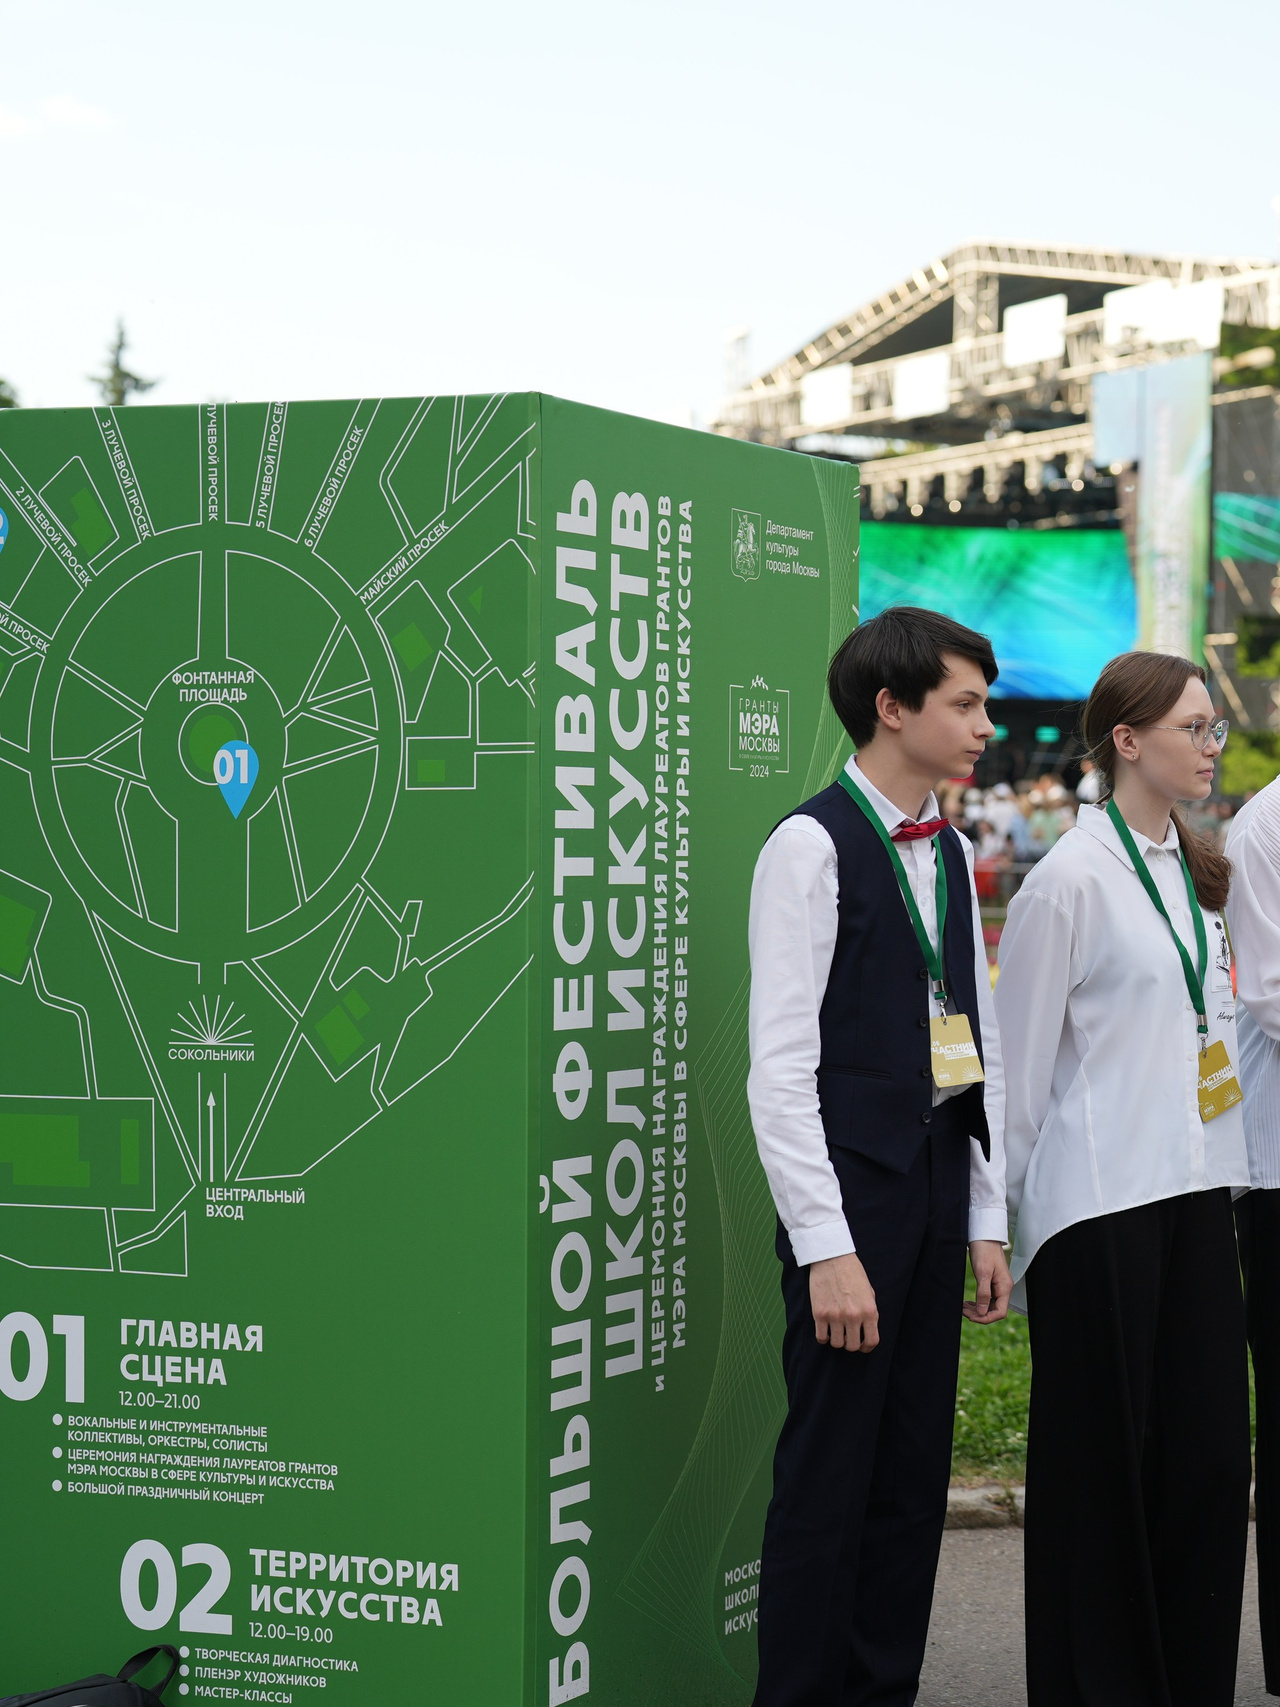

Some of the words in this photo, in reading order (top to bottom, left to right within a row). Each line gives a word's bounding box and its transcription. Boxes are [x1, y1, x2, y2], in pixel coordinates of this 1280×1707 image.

[101, 419, 112, 429] 3
[105, 430, 134, 488] ЛУЧЕВОЙ
[258, 455, 275, 518] ЛУЧЕВОЙ
[267, 401, 285, 452] ПРОСЕК
[208, 467, 218, 521] ПРОСЕК
[305, 539, 313, 547] 6
[309, 478, 340, 538] ЛУЧЕВОЙ
[335, 426, 363, 477] ПРОСЕК
[127, 489, 151, 540] ПРОСЕК
[16, 486, 24, 496] 2
[22, 495, 61, 545] ЛУЧЕВОЙ
[58, 543, 92, 587] ПРОСЕК
[766, 520, 814, 540] Департамент
[360, 556, 410, 604] МАЙСКИЙ
[407, 520, 449, 561] ПРОСЕК
[766, 542, 798, 558] культуры
[656, 496, 671, 650] ГРАНТОВ
[766, 560, 790, 574] города
[793, 561, 819, 577] Москвы
[677, 501, 692, 703] ИСКУССТВА
[9, 620, 50, 653] ПРОСЕК
[172, 671, 255, 687] ФОНТАННАЯ
[179, 688, 248, 704] ПЛОЩАДЬ
[739, 698, 779, 713] ГРАНТЫ
[677, 715, 689, 736] И
[740, 712, 779, 735] МЭРА
[739, 736, 780, 752] МОСКВЫ
[213, 749, 250, 784] 01
[607, 491, 650, 1032] ИСКУССТВ
[655, 662, 669, 863] ЛАУРЕАТОВ
[750, 764, 769, 777] 2024
[552, 479, 598, 1120] ФЕСТИВАЛЬ
[675, 748, 689, 924] КУЛЬТУРЫ
[652, 872, 668, 1135] НАГРАЖДЕНИЯ
[674, 937, 688, 1054] СФЕРЕ
[169, 1049, 254, 1061] СОКОЛЬНИКИ
[931, 1042, 976, 1055] ЧАСТНИК
[674, 1061, 686, 1080] В
[1198, 1063, 1233, 1089] ЧАСТНИК
[674, 1101, 686, 1246] МОСКВЫ
[206, 1188, 304, 1203] ЦЕНТРАЛЬНЫЙ
[207, 1205, 243, 1220] ВХОД
[606, 1069, 646, 1378] ШКОЛ
[652, 1147, 666, 1365] ЦЕРЕМОНИЯ
[673, 1258, 686, 1349] МЭРА
[121, 1319, 262, 1352] ГЛАВНАЯ
[0, 1311, 85, 1403] 01
[120, 1354, 227, 1387] СЦЕНА
[656, 1376, 664, 1391] и
[69, 1416, 136, 1429] ВОКАЛЬНЫЕ
[140, 1420, 146, 1430] И
[150, 1420, 267, 1437] ИНСТРУМЕНТАЛЬНЫЕ
[540, 1156, 592, 1707] БОЛЬШОЙ
[68, 1431, 145, 1446] КОЛЛЕКТИВЫ,
[148, 1435, 209, 1450] ОРКЕСТРЫ,
[213, 1439, 267, 1452] СОЛИСТЫ
[69, 1449, 136, 1462] ЦЕРЕМОНИЯ
[140, 1453, 220, 1467] НАГРАЖДЕНИЯ
[223, 1458, 285, 1472] ЛАУРЕАТОВ
[289, 1462, 338, 1475] ГРАНТОВ
[68, 1464, 96, 1475] МЭРА
[100, 1466, 148, 1478] МОСКВЫ
[152, 1469, 158, 1478] В
[161, 1469, 196, 1481] СФЕРЕ
[200, 1472, 255, 1485] КУЛЬТУРЫ
[259, 1475, 266, 1485] И
[270, 1476, 334, 1490] ИСКУССТВА
[68, 1482, 124, 1495] БОЛЬШОЙ
[128, 1486, 210, 1500] ПРАЗДНИЧНЫЙ
[213, 1491, 264, 1504] КОНЦЕРТ
[250, 1549, 458, 1591] ТЕРРИТОРИЯ
[725, 1559, 762, 1587] моско
[120, 1540, 232, 1635] 02
[725, 1584, 760, 1611] школ
[252, 1584, 442, 1626] ИСКУССТВА
[725, 1608, 759, 1635] искус
[195, 1648, 269, 1664] ТВОРЧЕСКАЯ
[273, 1655, 358, 1671] ДИАГНОСТИКА
[196, 1667, 241, 1680] ПЛЕНЭР
[245, 1671, 326, 1687] ХУДОЖНИКОВ
[195, 1686, 291, 1703] МАСТЕР-КЛАССЫ
